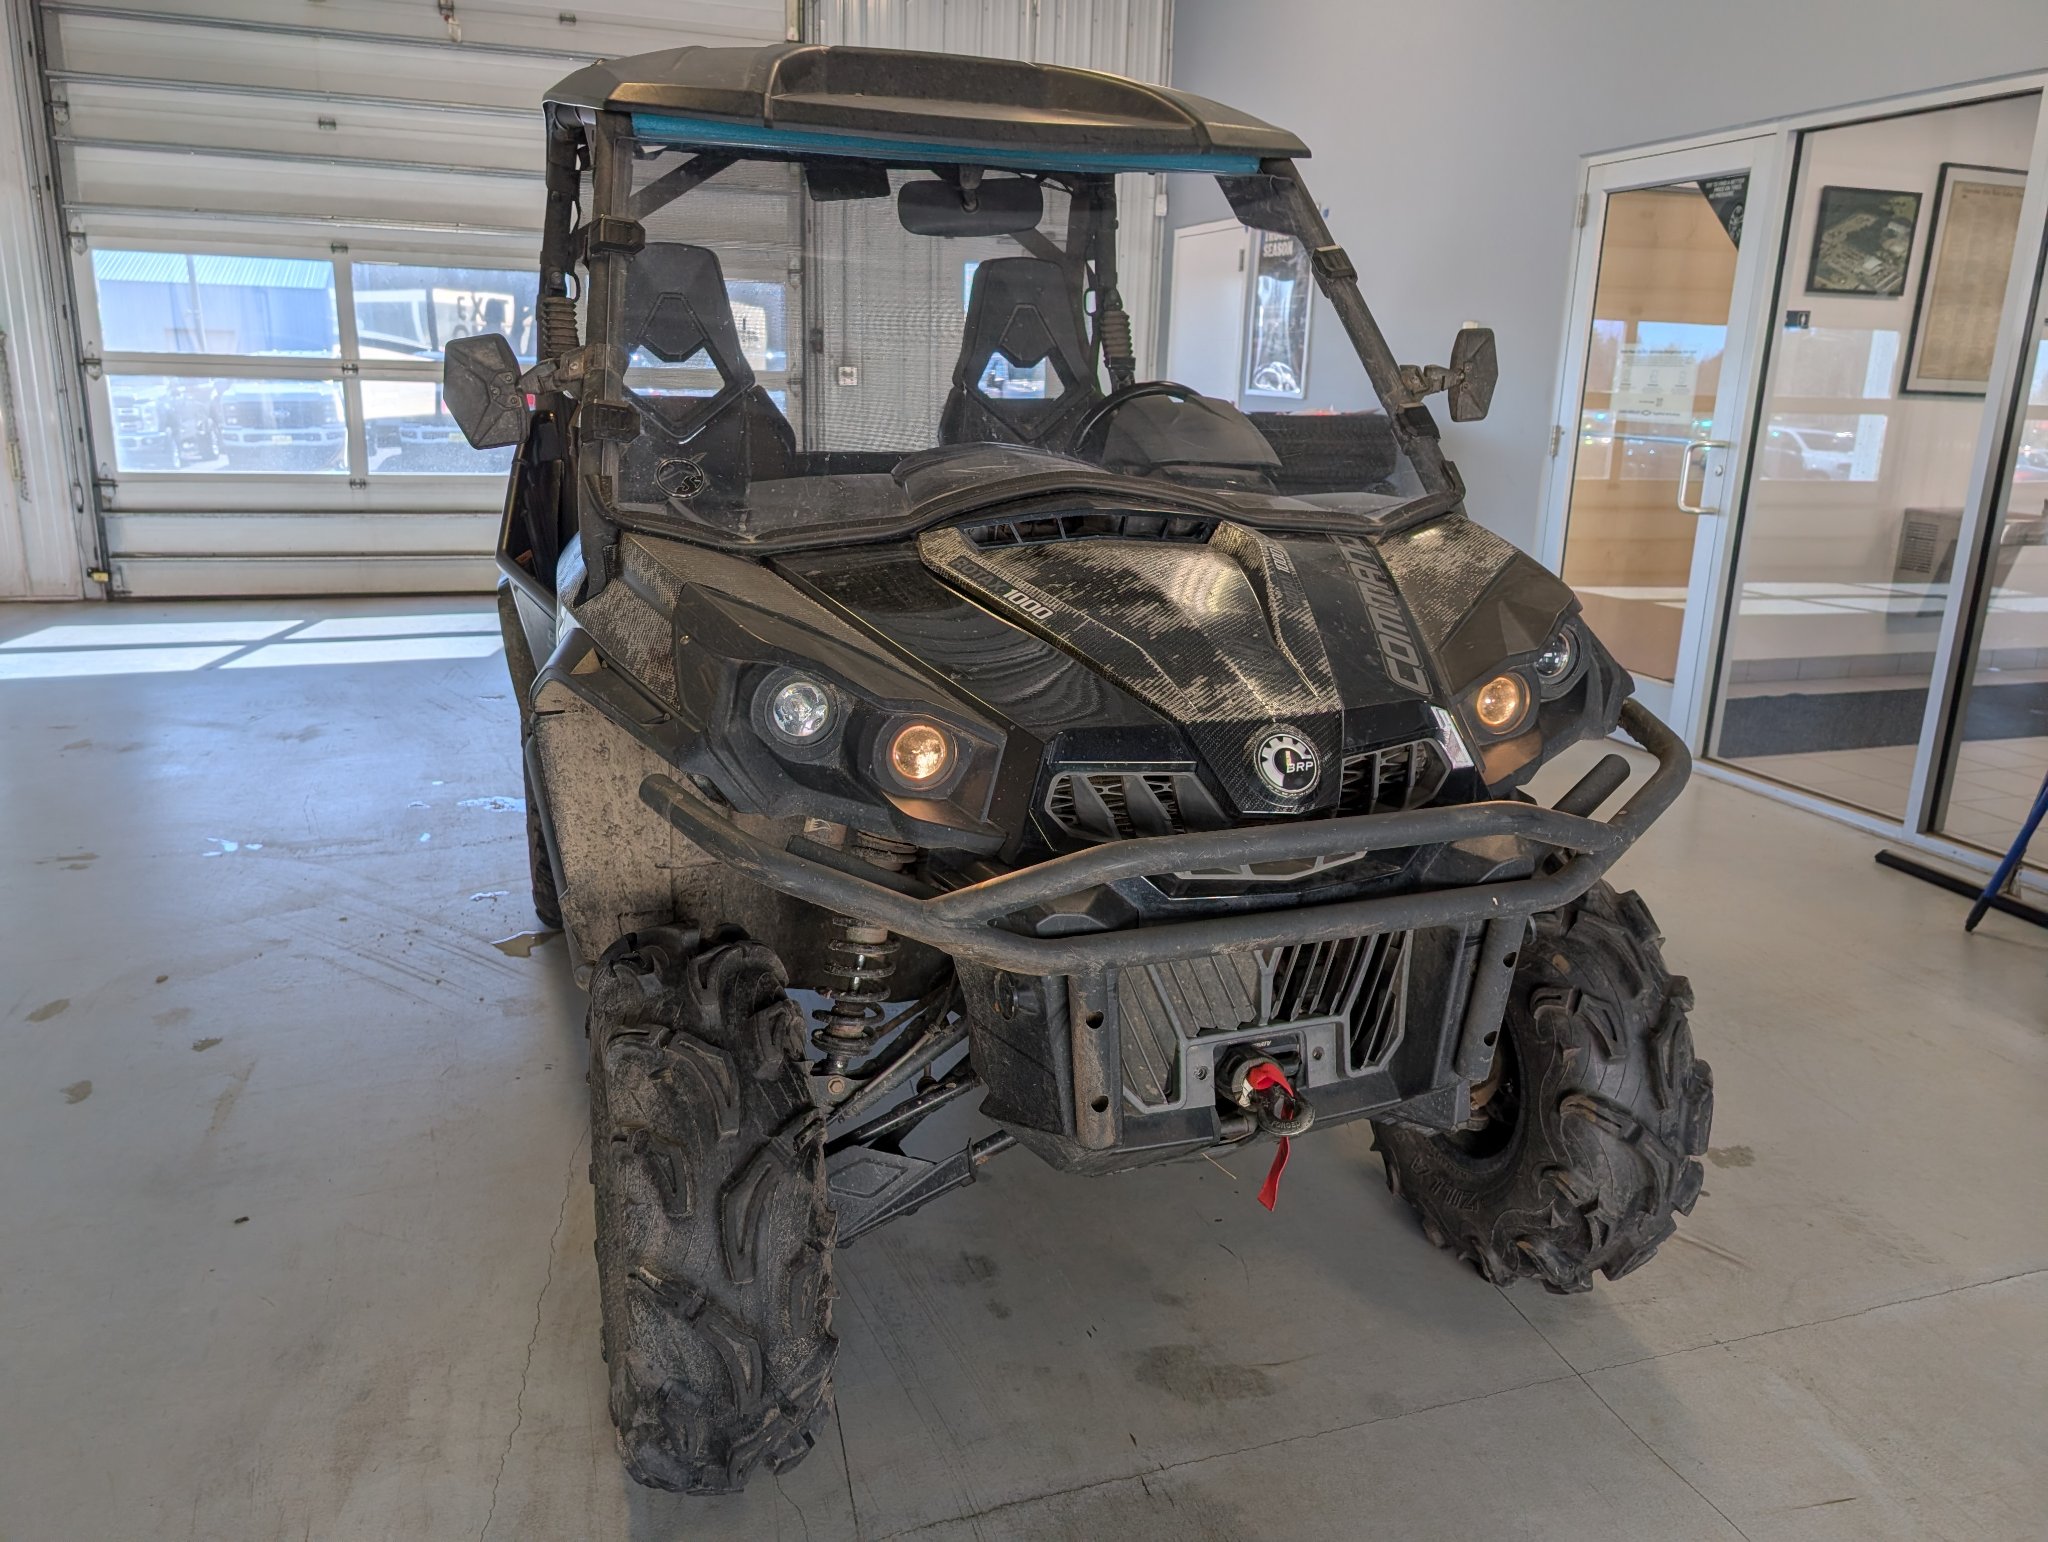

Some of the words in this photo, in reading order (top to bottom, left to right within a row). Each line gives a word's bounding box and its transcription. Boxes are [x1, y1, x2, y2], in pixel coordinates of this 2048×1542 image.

[1263, 240, 1294, 258] SEASON
[951, 557, 1007, 592] ROTAX
[1002, 588, 1055, 620] 1000
[1286, 761, 1314, 774] BRP
